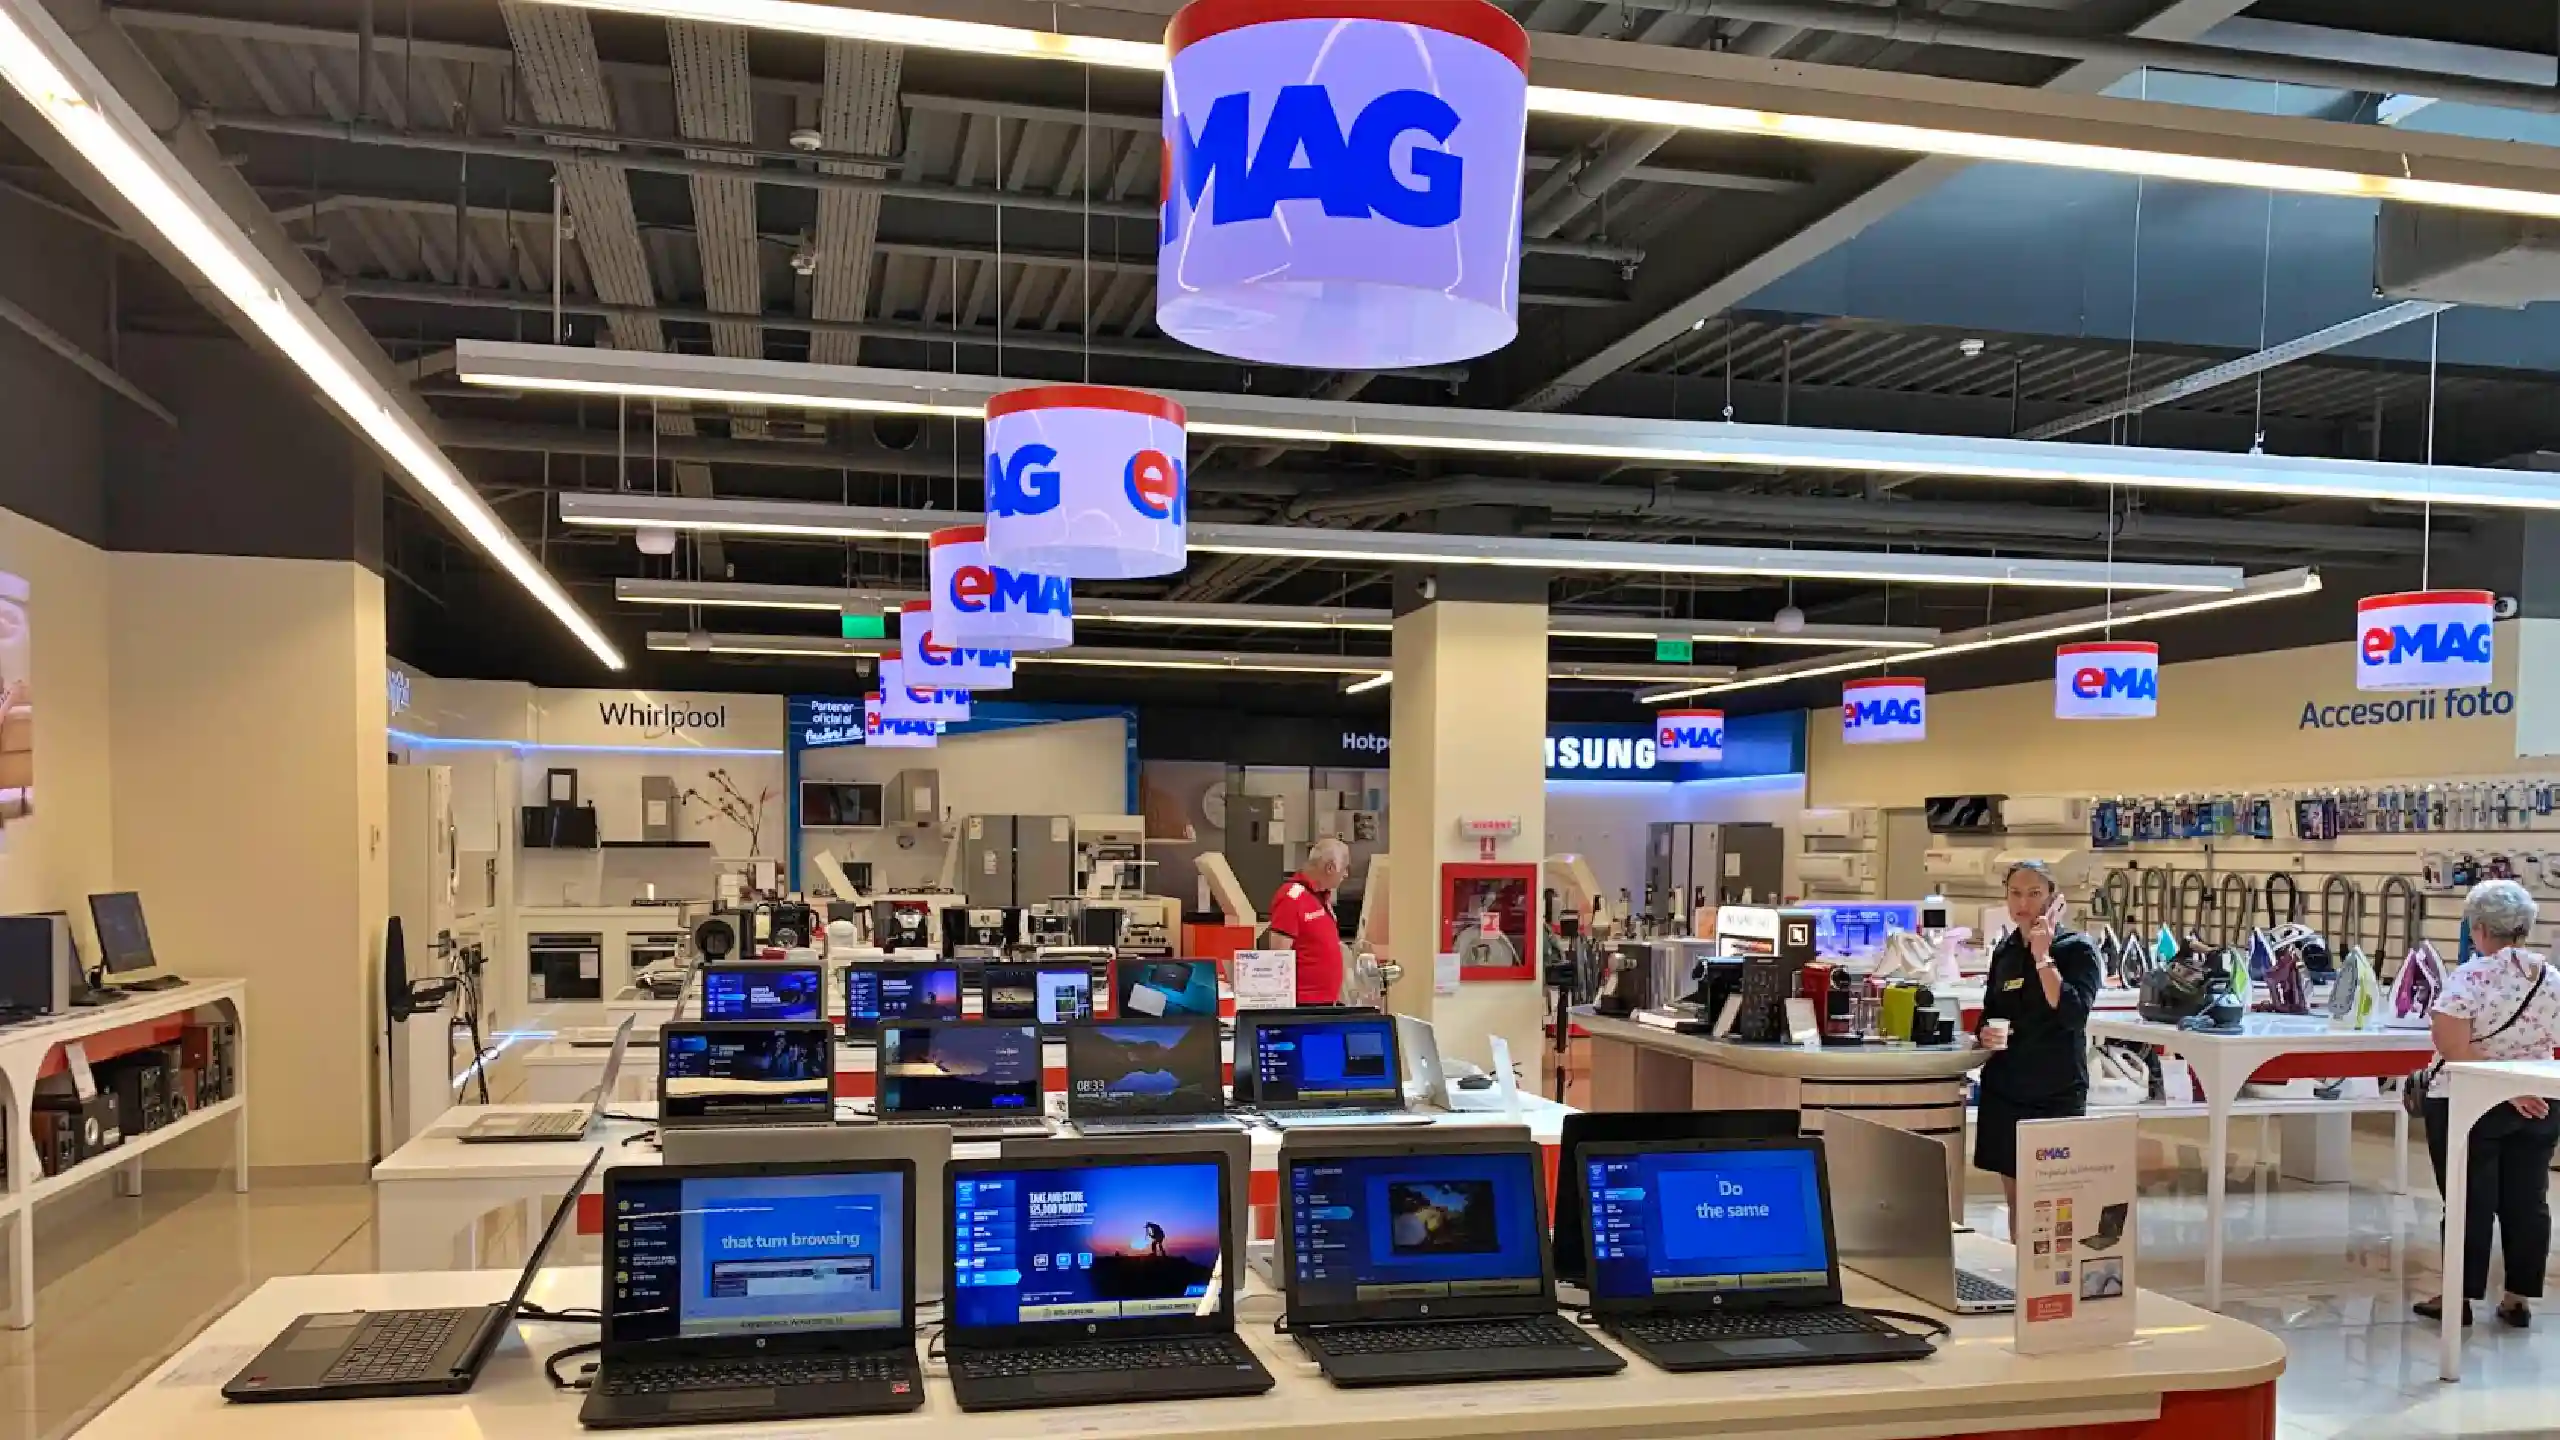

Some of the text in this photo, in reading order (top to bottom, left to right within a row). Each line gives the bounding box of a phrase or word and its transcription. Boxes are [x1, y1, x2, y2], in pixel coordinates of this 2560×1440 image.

[1161, 84, 1463, 247] MAG
[2363, 621, 2491, 666] eMAG
[2072, 667, 2156, 700] eMA
[599, 701, 726, 734] Whirlpool
[1844, 698, 1921, 728] eMAG
[2299, 686, 2515, 731] Accesorii foto
[1342, 732, 1391, 754] Hotp
[1719, 1180, 1743, 1196] Do
[1696, 1203, 1769, 1219] the same
[722, 1235, 753, 1249] that
[791, 1229, 861, 1250] browsing
